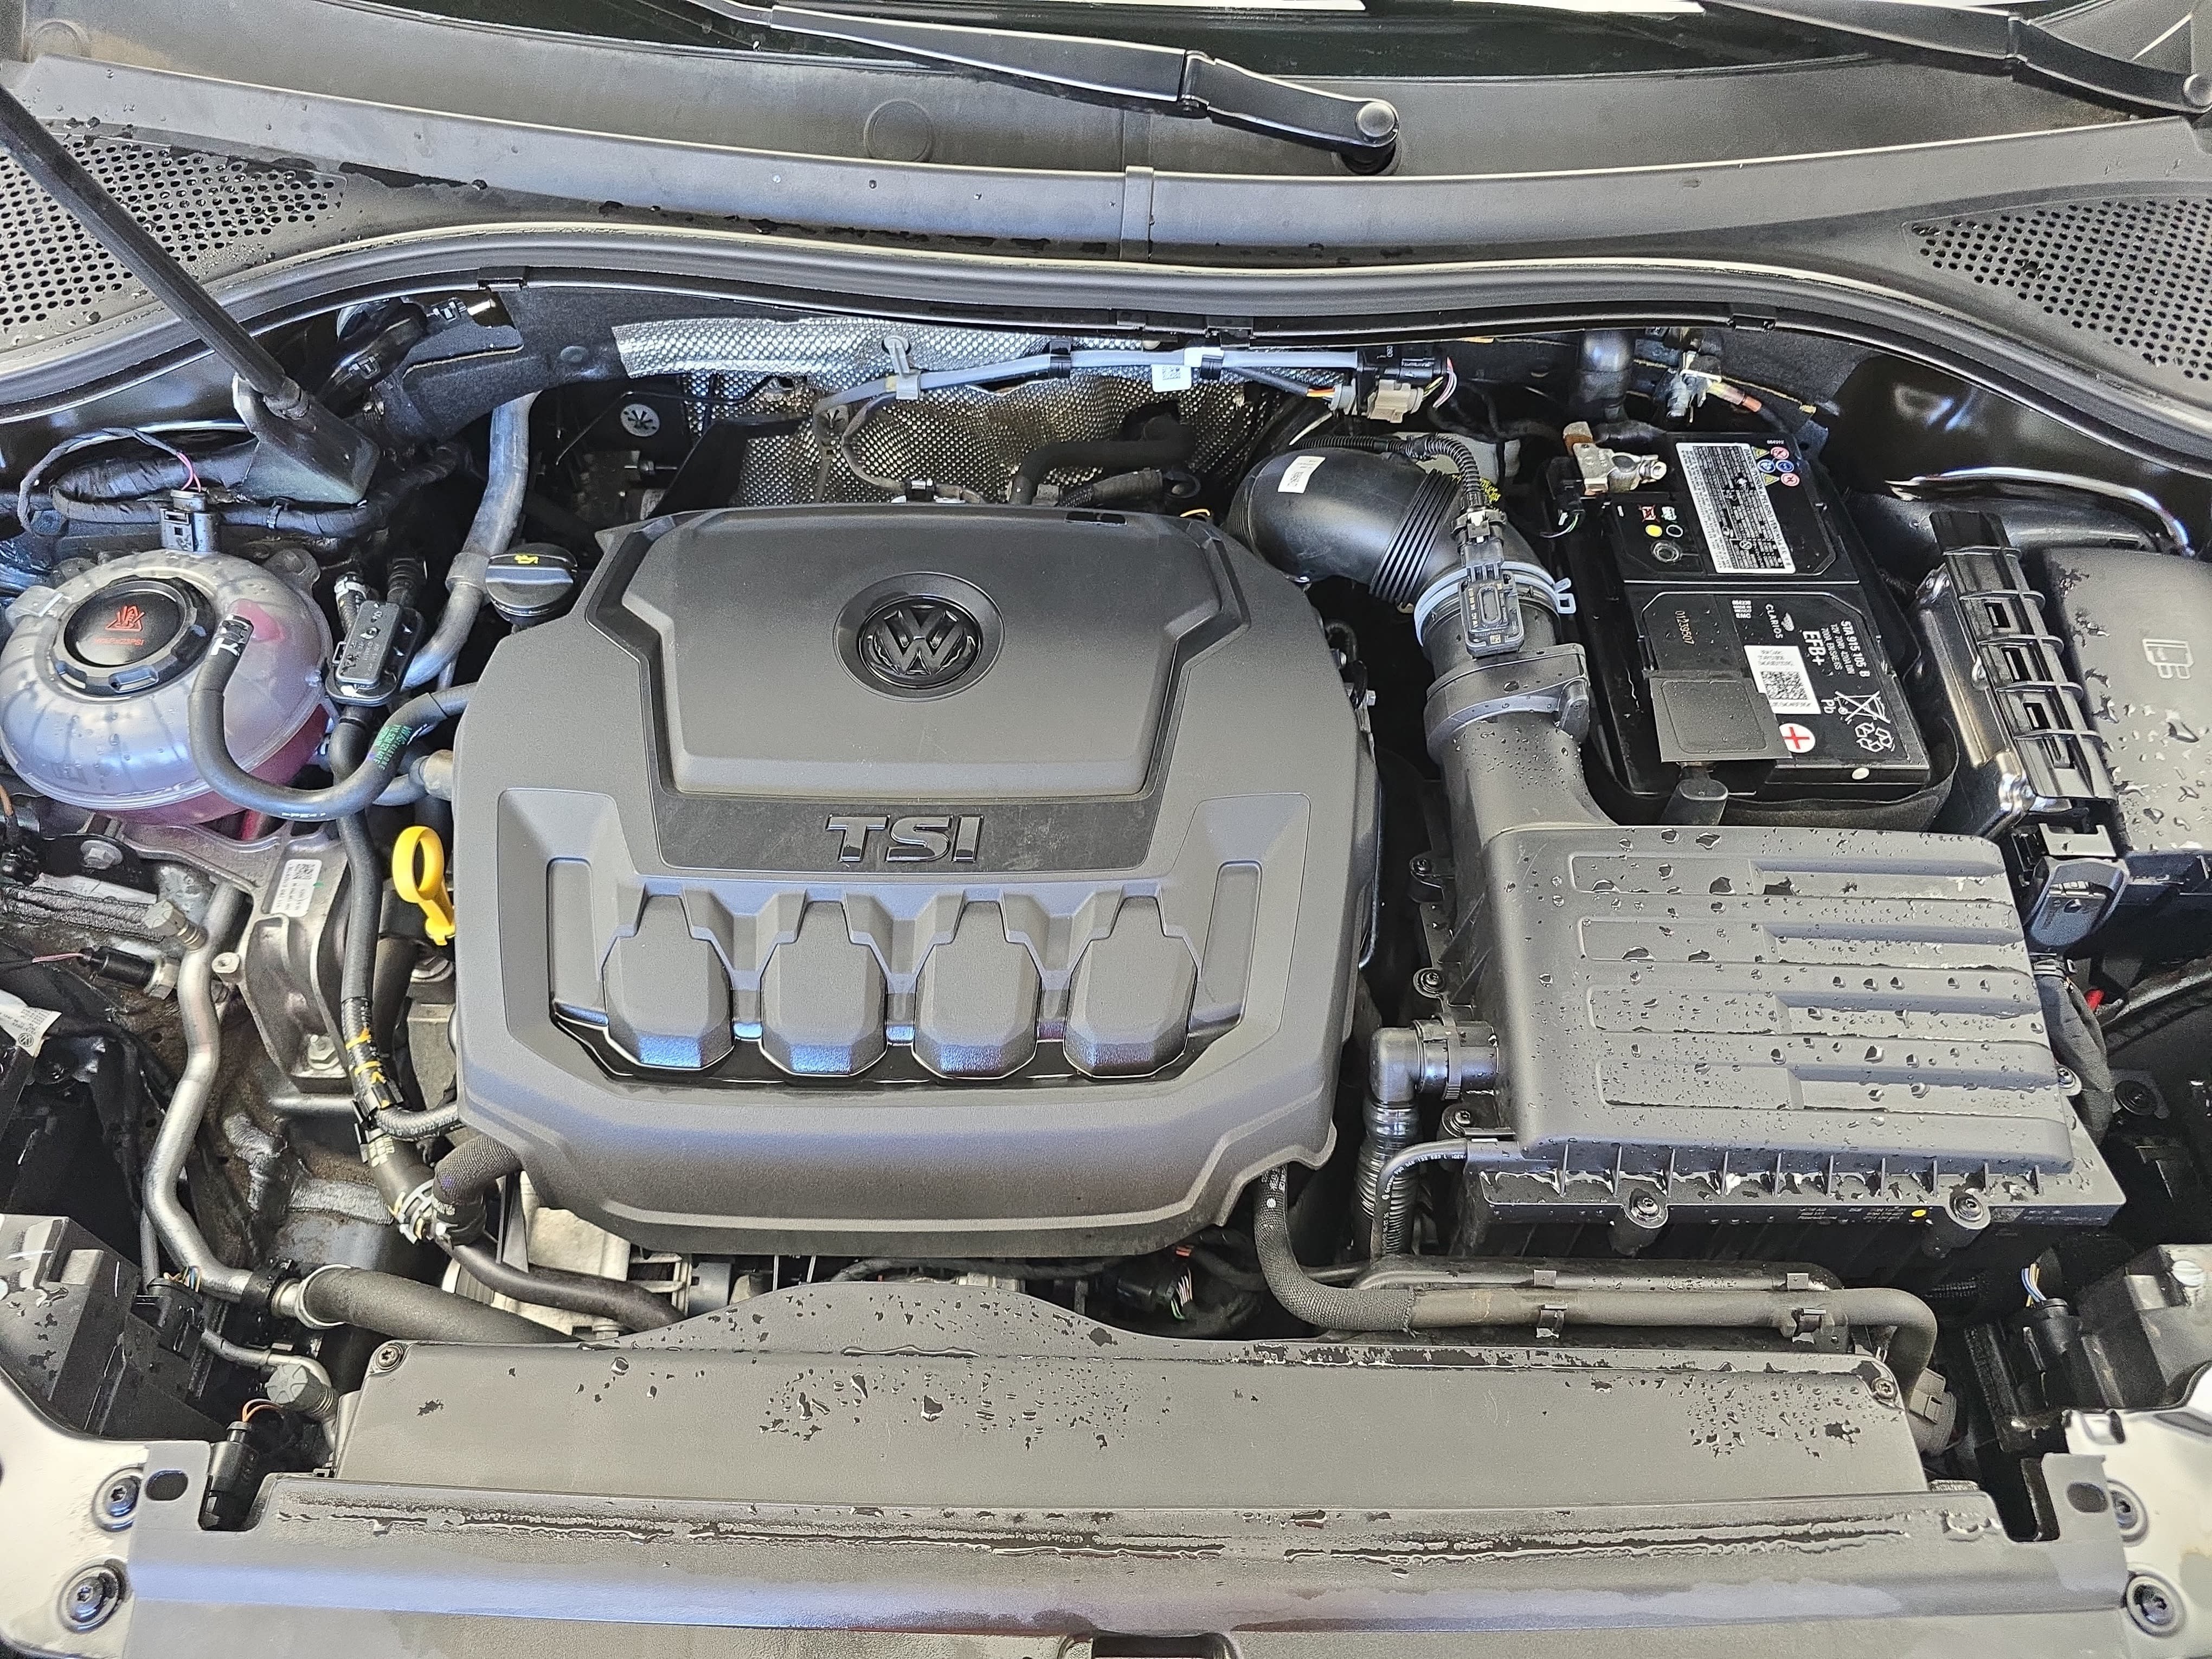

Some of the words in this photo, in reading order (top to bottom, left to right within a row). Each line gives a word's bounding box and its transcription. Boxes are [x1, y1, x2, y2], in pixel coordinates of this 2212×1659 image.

[1675, 610, 1695, 645] 01239507
[1766, 603, 1783, 639] CLARIOS
[1802, 631, 1827, 666] EFB+
[1846, 636, 1861, 652] 915
[1853, 653, 1867, 667] 105
[1821, 699, 1837, 714] Pb
[826, 813, 984, 863] TSI
